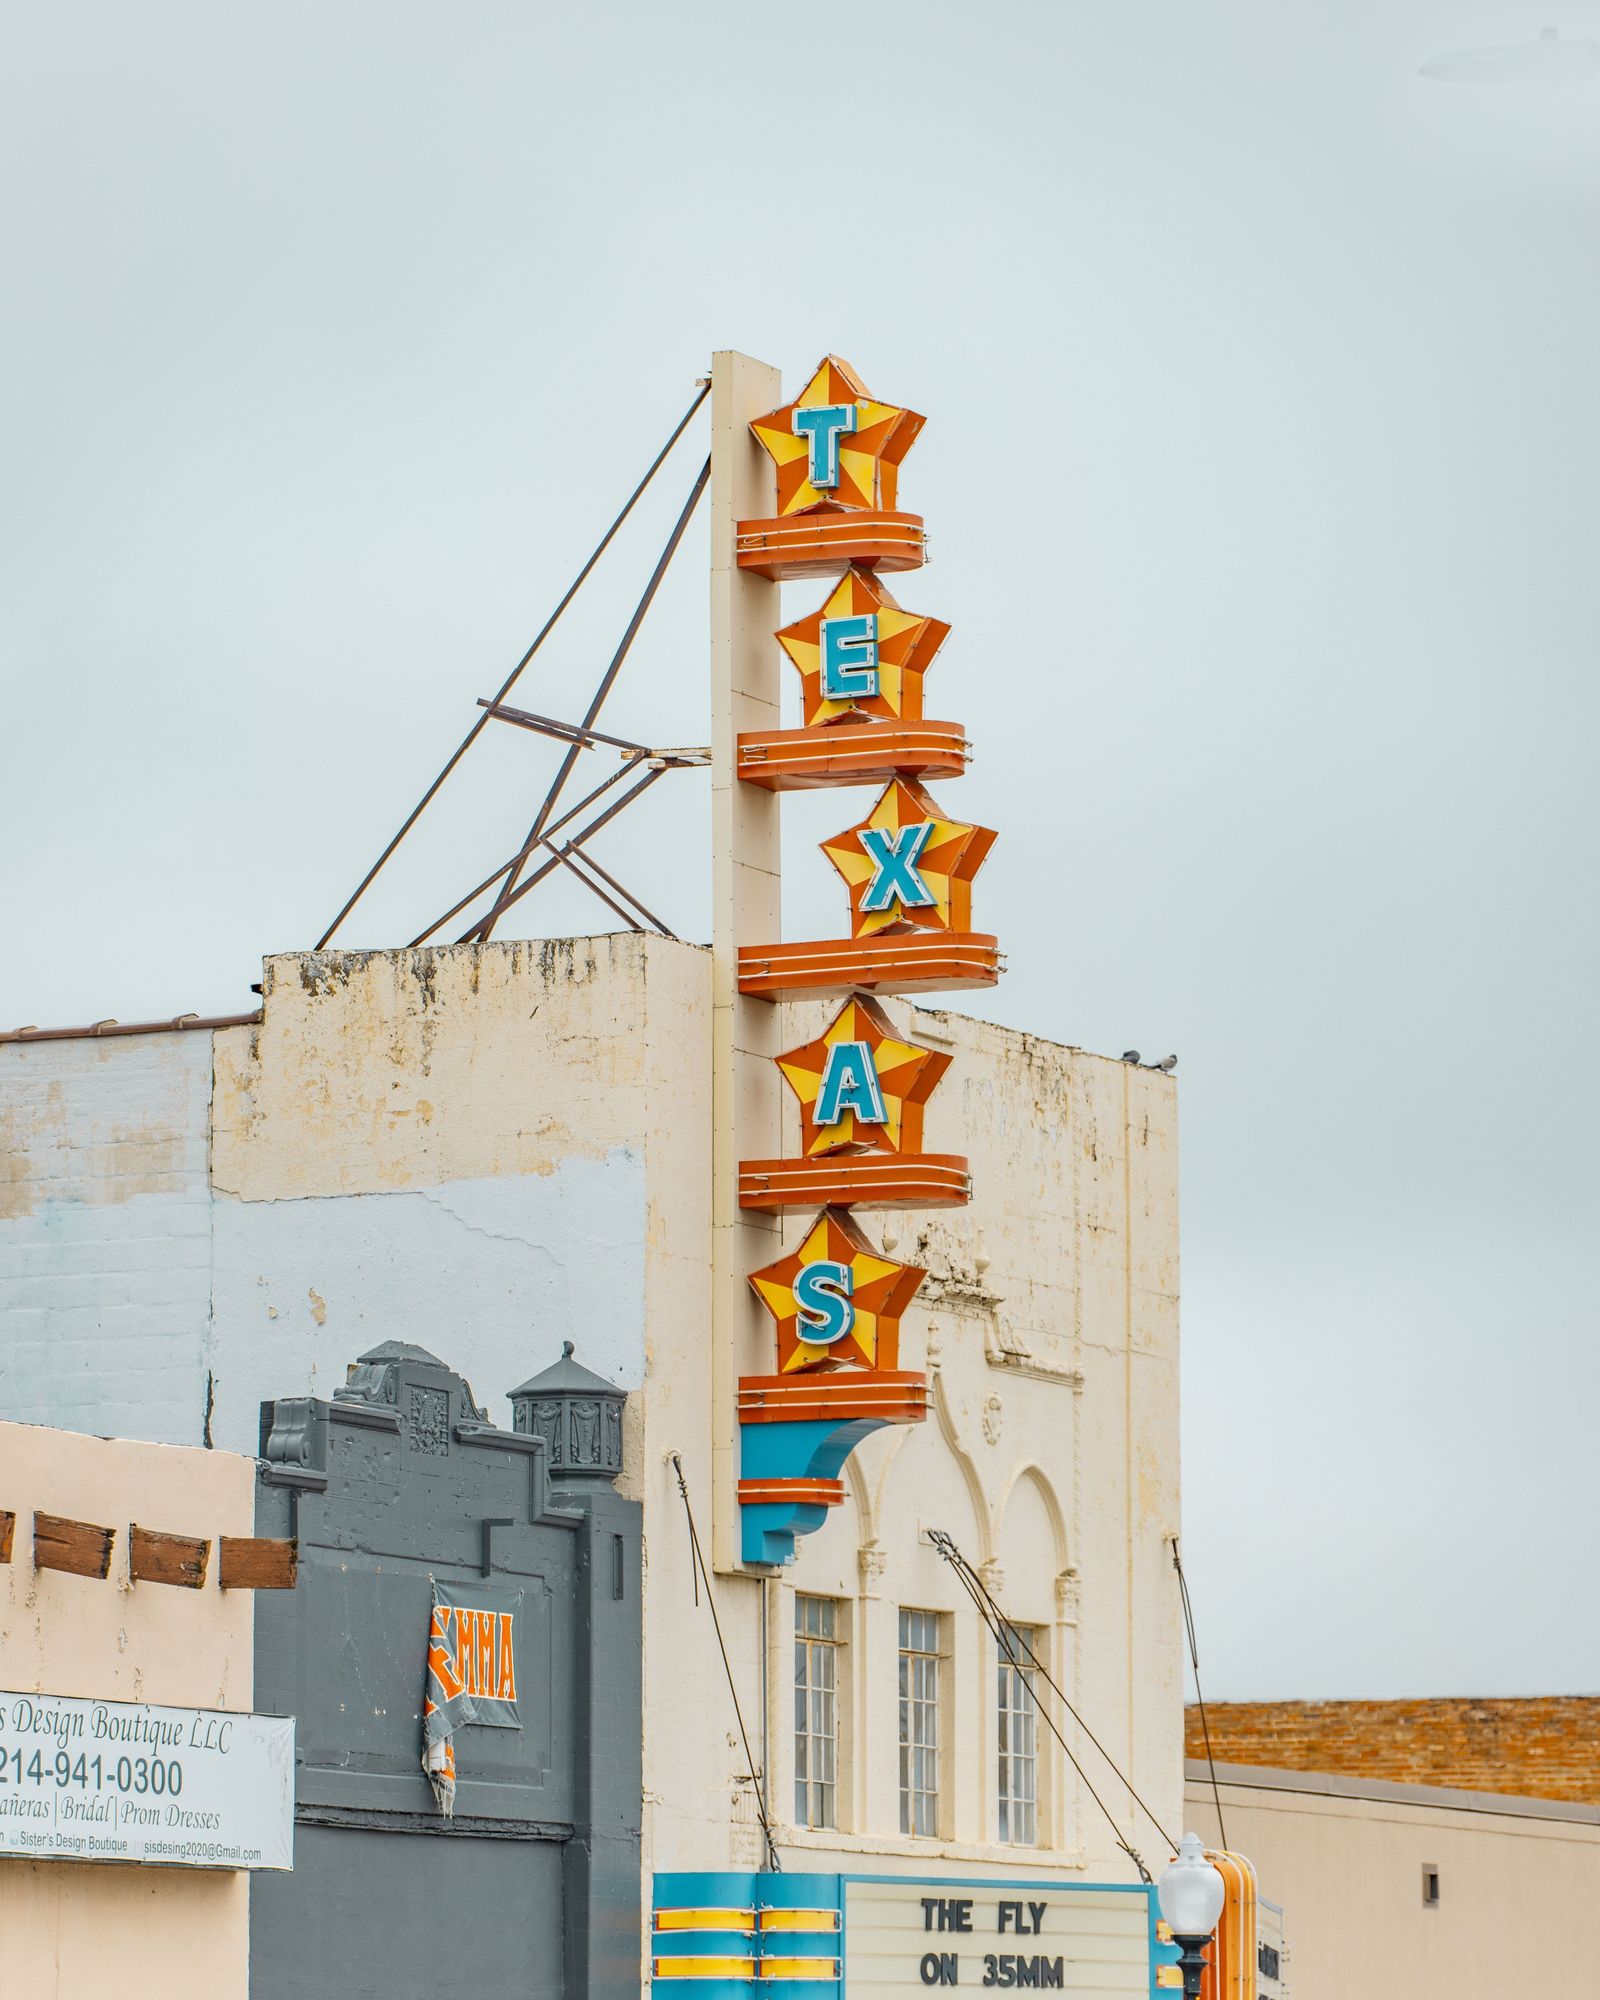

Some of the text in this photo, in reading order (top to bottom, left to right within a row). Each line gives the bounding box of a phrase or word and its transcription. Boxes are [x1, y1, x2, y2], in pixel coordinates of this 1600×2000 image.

[791, 403, 938, 1345] TEXAS
[12, 1699, 84, 1749] Design
[91, 1705, 183, 1757] Boutique
[188, 1717, 233, 1754] LLC
[0, 1746, 183, 1796] 214-941-0300
[61, 1795, 114, 1822] Bridal
[121, 1800, 161, 1826] Prom
[165, 1804, 221, 1830] Dresses
[20, 1830, 54, 1847] Sister's
[56, 1833, 87, 1852] Design
[89, 1835, 128, 1854] Boutique
[144, 1839, 262, 1861] sisdesing2020@Gmail.com
[921, 1898, 1048, 1934] THE FLY
[920, 1952, 1064, 1989] ON 35MM
